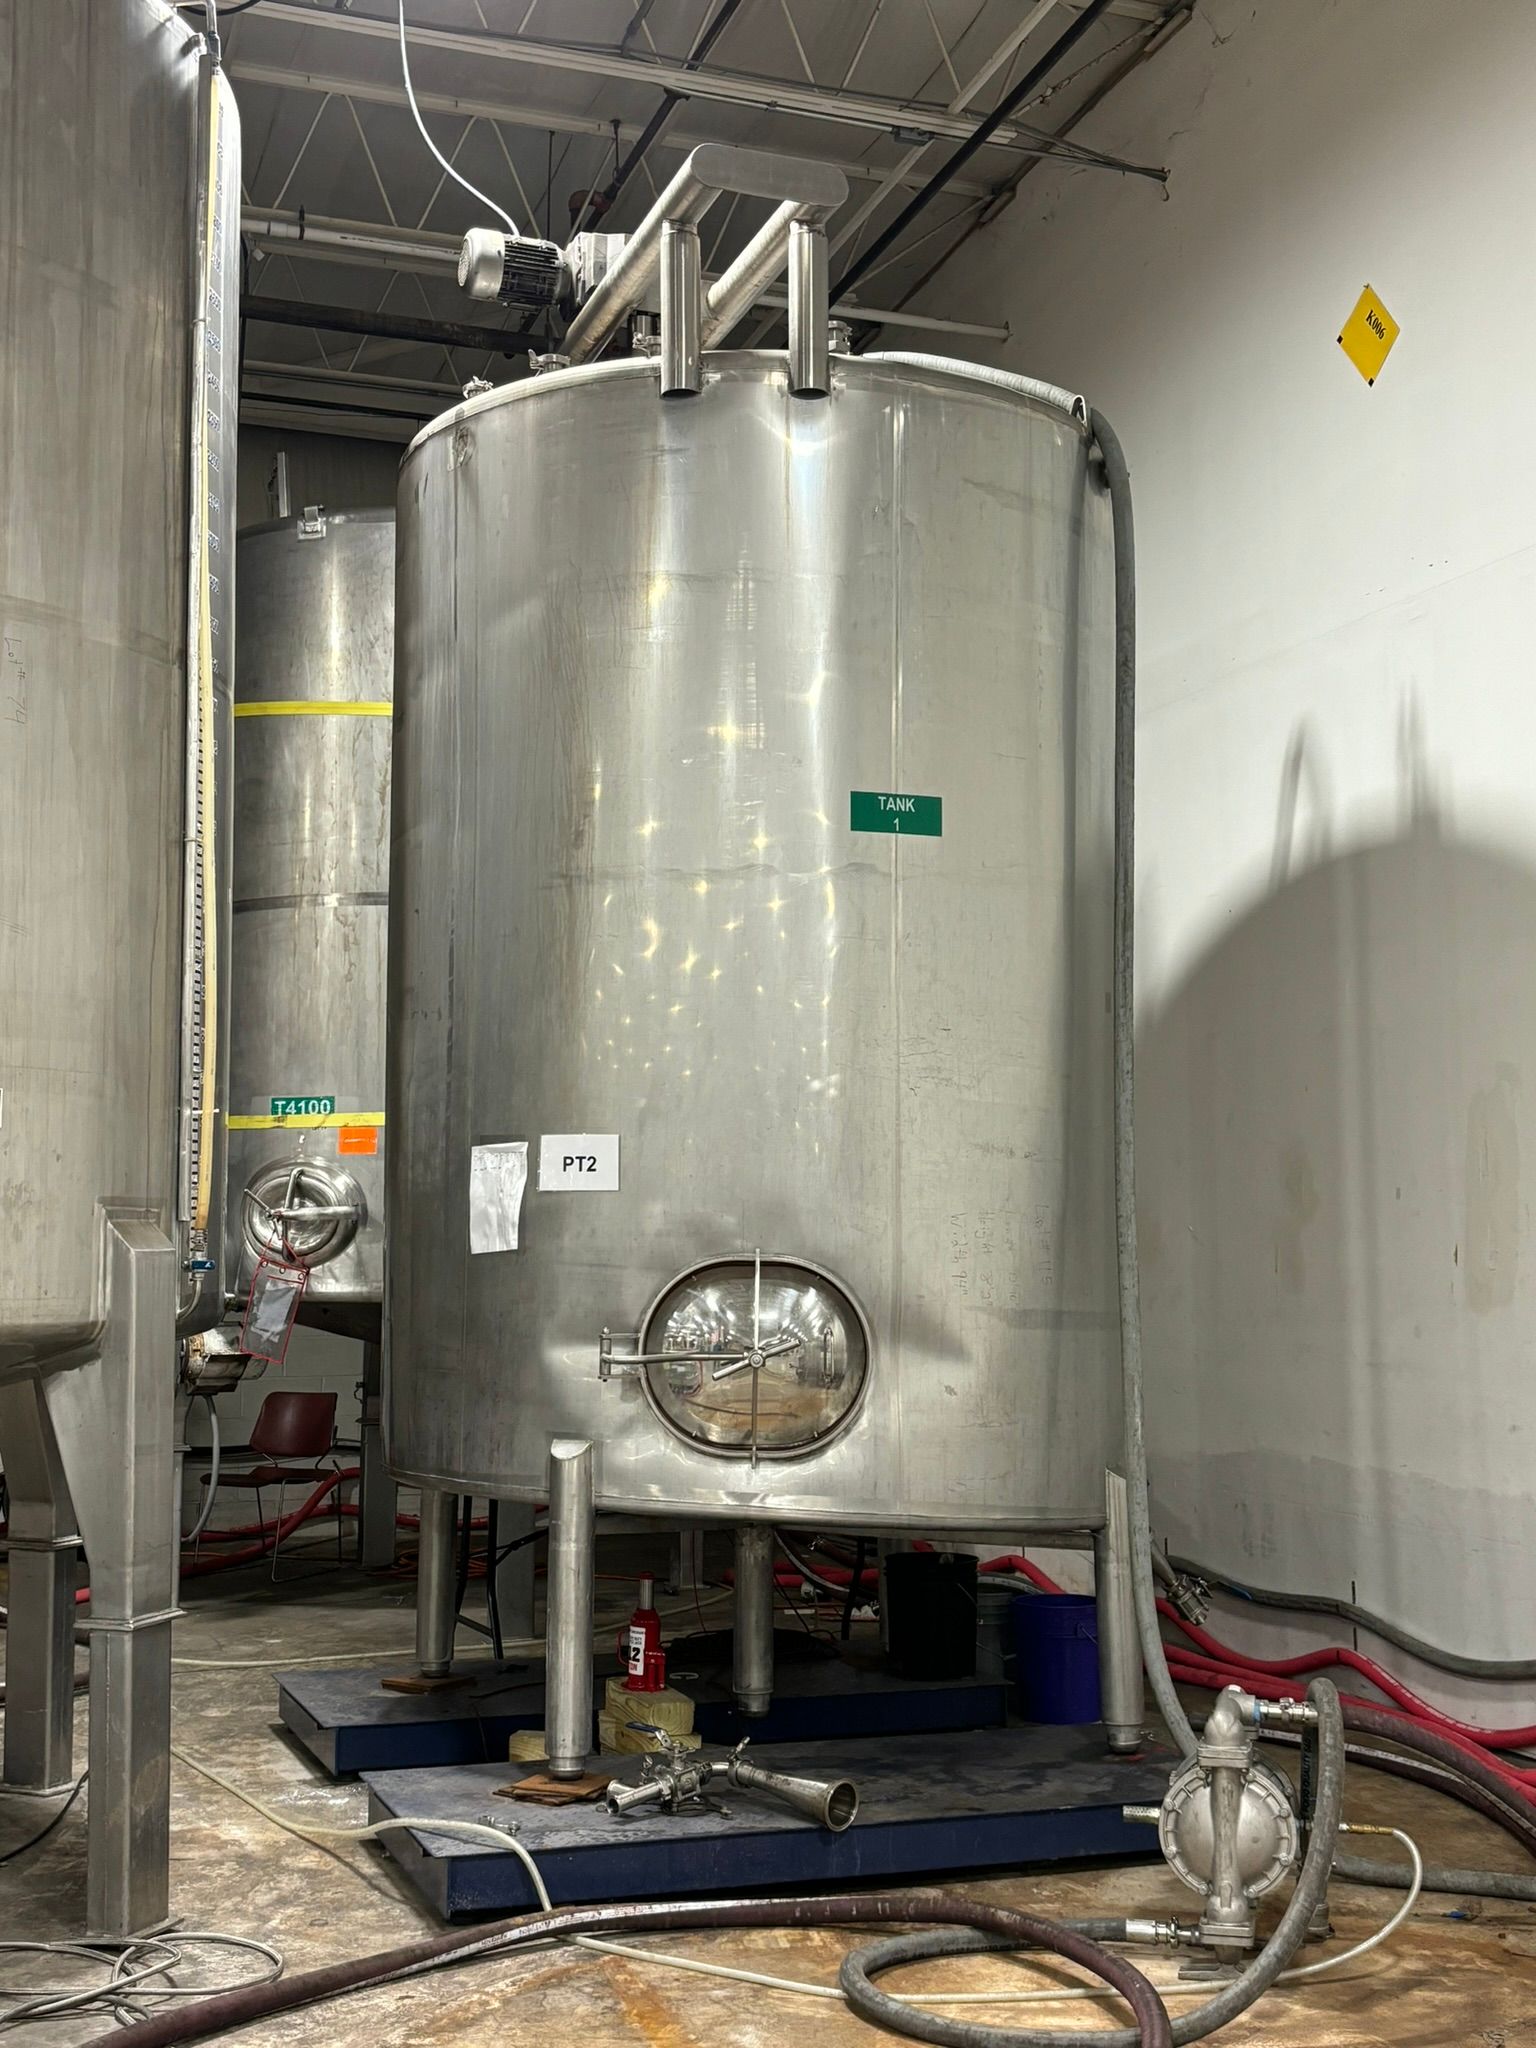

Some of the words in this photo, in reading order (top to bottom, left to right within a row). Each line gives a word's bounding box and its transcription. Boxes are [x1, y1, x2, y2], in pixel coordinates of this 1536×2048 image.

[1366, 309, 1387, 340] K006
[878, 796, 915, 813] TANK
[893, 817, 900, 832] 1
[274, 1099, 331, 1116] T4100
[562, 1156, 597, 1173] PT2
